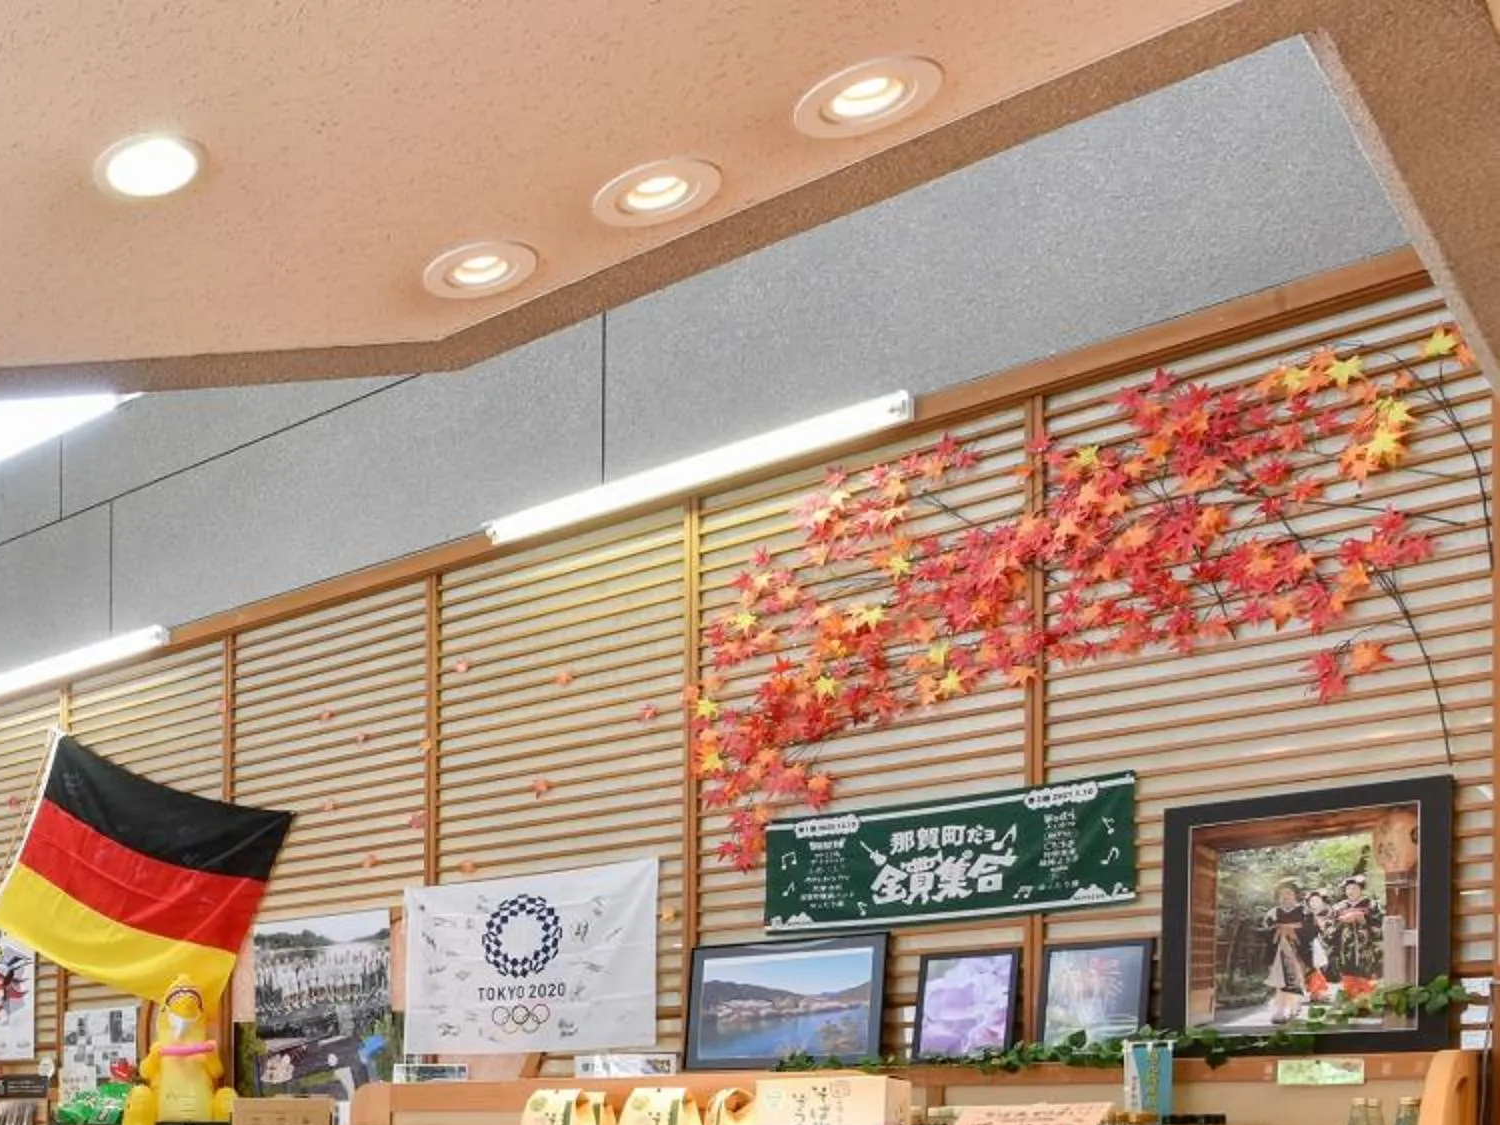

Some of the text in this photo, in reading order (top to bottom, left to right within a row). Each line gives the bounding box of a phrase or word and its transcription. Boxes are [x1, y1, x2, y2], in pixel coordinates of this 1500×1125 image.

[871, 849, 1019, 905] 全員集合
[478, 982, 566, 1000] TOKYO 2020
